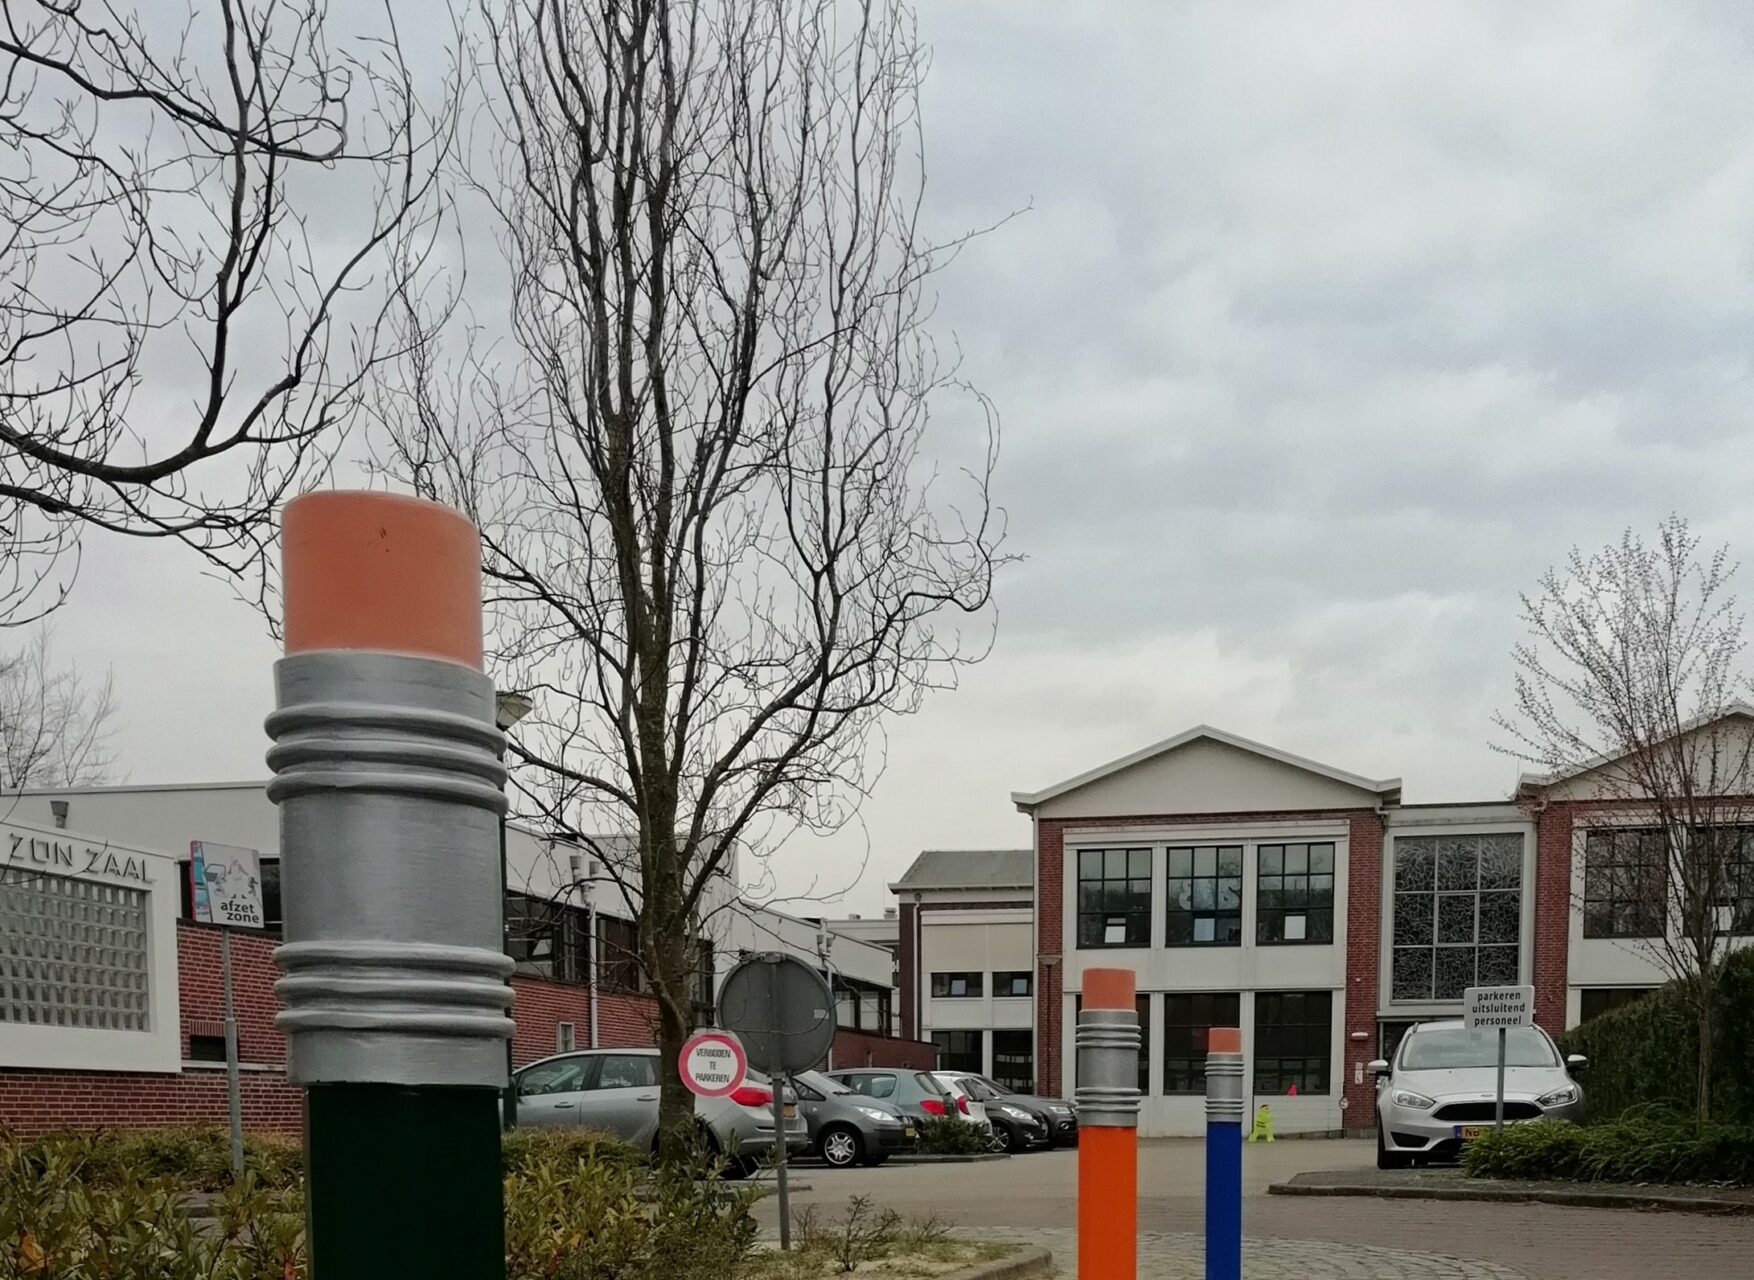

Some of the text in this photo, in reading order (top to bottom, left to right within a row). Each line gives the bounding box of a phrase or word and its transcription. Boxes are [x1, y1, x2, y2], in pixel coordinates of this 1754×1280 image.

[9, 832, 155, 883] ZON ZAAL
[220, 900, 255, 914] afzet
[226, 911, 260, 923] zone
[1477, 991, 1521, 1003] parkeren
[1472, 1003, 1525, 1013] uitsluitend
[1474, 1015, 1522, 1028] personeel
[696, 1047, 731, 1058] VERBODEN
[709, 1061, 717, 1070] TE
[695, 1072, 730, 1083] PARKEREN
